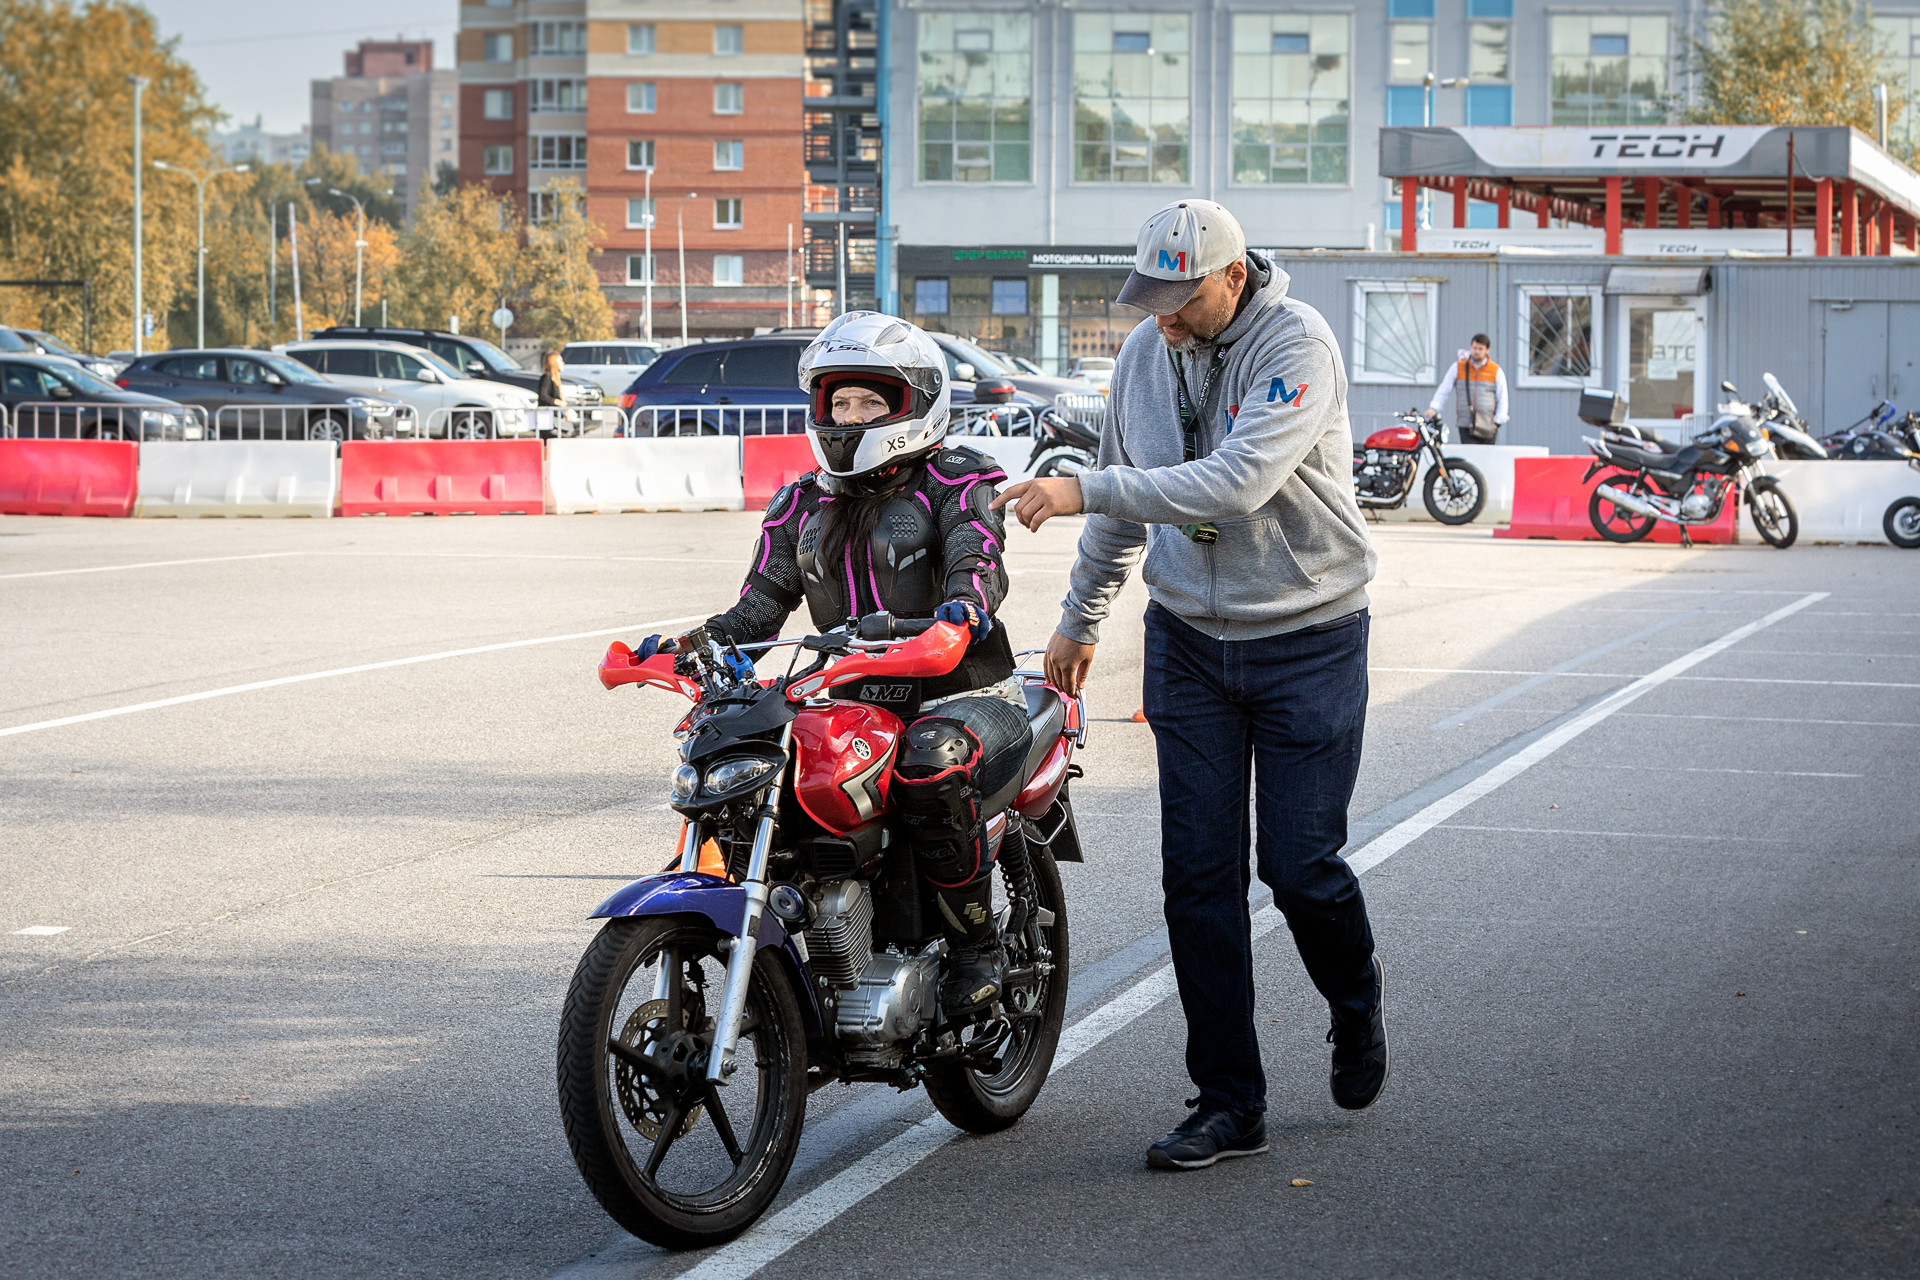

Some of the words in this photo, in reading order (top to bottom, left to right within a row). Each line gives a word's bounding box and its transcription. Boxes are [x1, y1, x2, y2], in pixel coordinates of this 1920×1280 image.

[1589, 134, 1725, 158] TECH
[1452, 240, 1490, 249] TECH
[1658, 244, 1698, 253] TECH
[1032, 254, 1098, 265] МОТОЦИКЛЫ
[1158, 249, 1186, 273] M1
[1266, 377, 1309, 407] M1
[886, 435, 906, 453] XS
